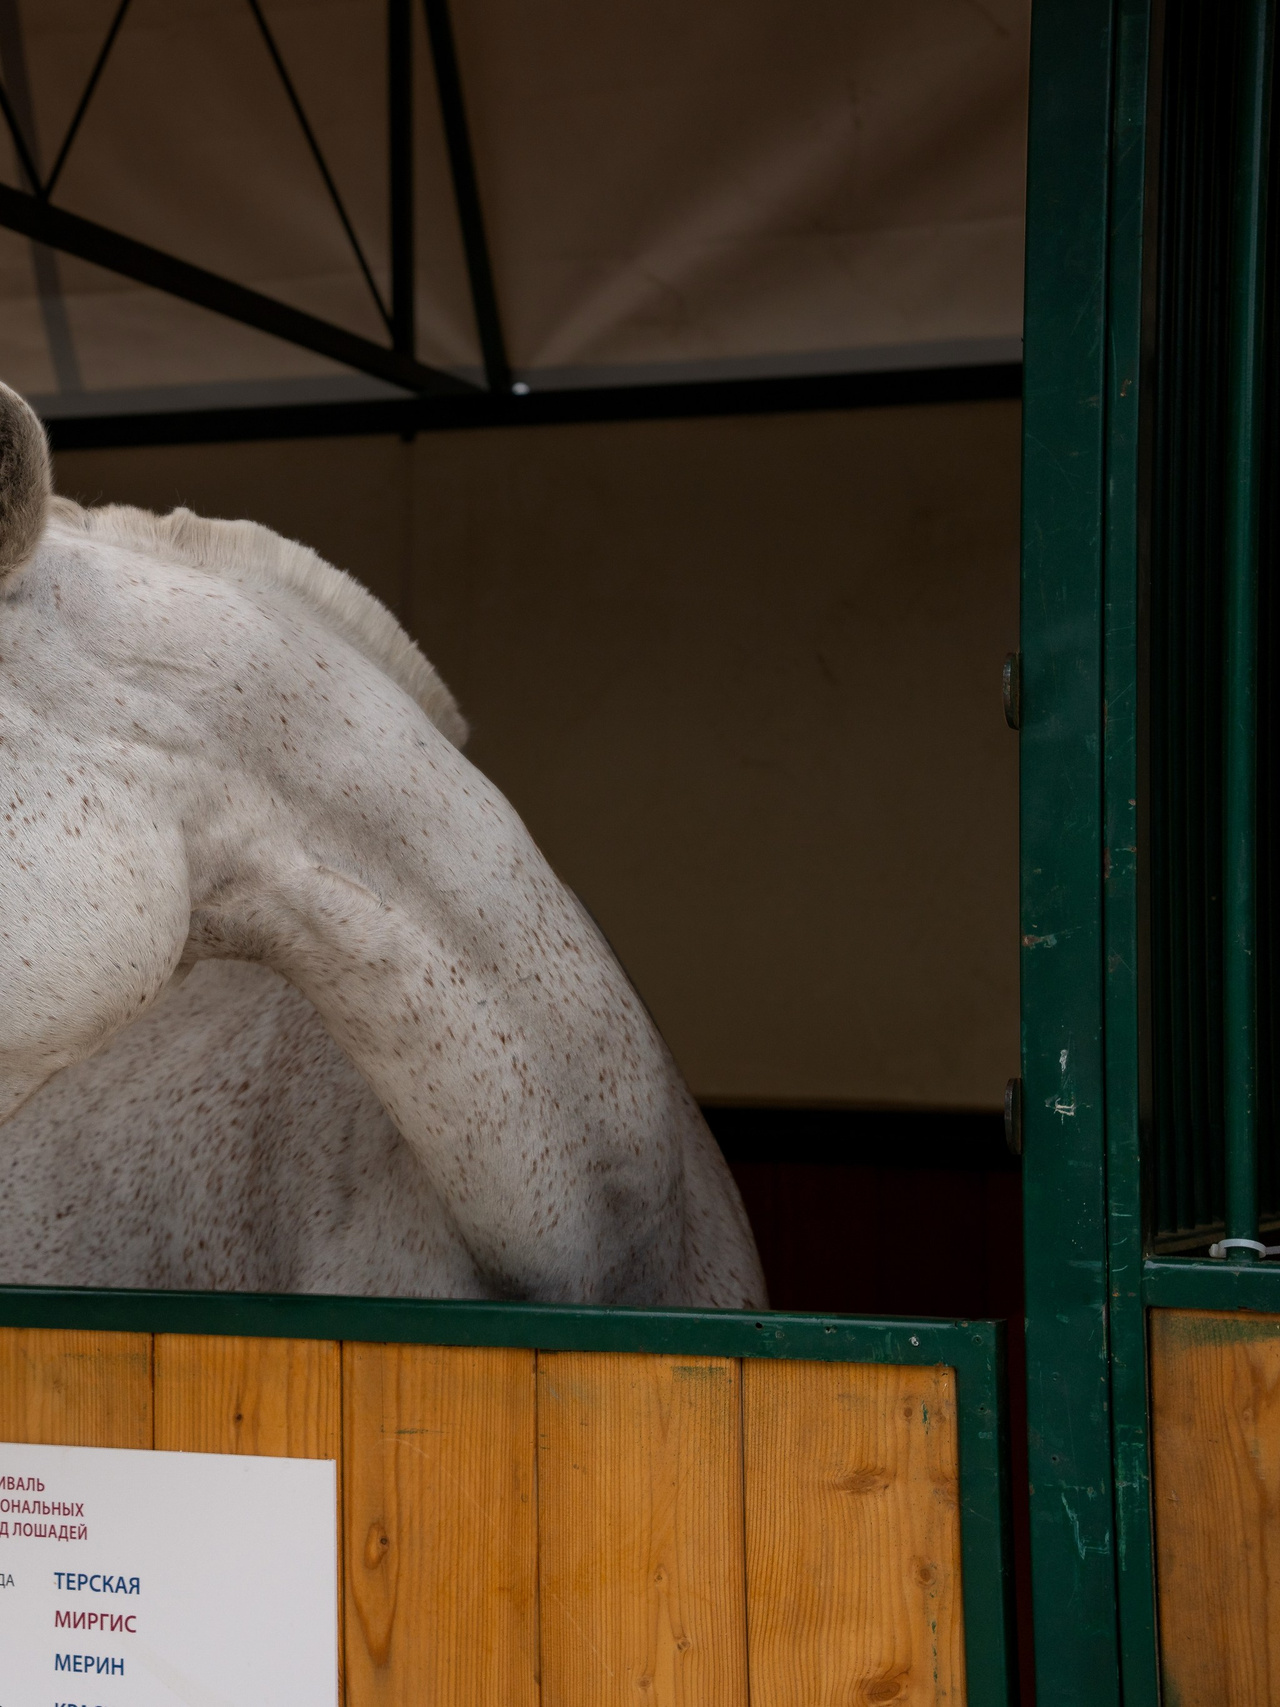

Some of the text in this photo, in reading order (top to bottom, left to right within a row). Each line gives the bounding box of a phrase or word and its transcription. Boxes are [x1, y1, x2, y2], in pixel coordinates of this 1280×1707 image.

[12, 1522, 87, 1541] ЛОШАДЕЙ
[54, 1572, 140, 1595] ТЕРСКАЯ
[55, 1610, 137, 1633] МИРГИС
[55, 1654, 124, 1677] МЕРИН
